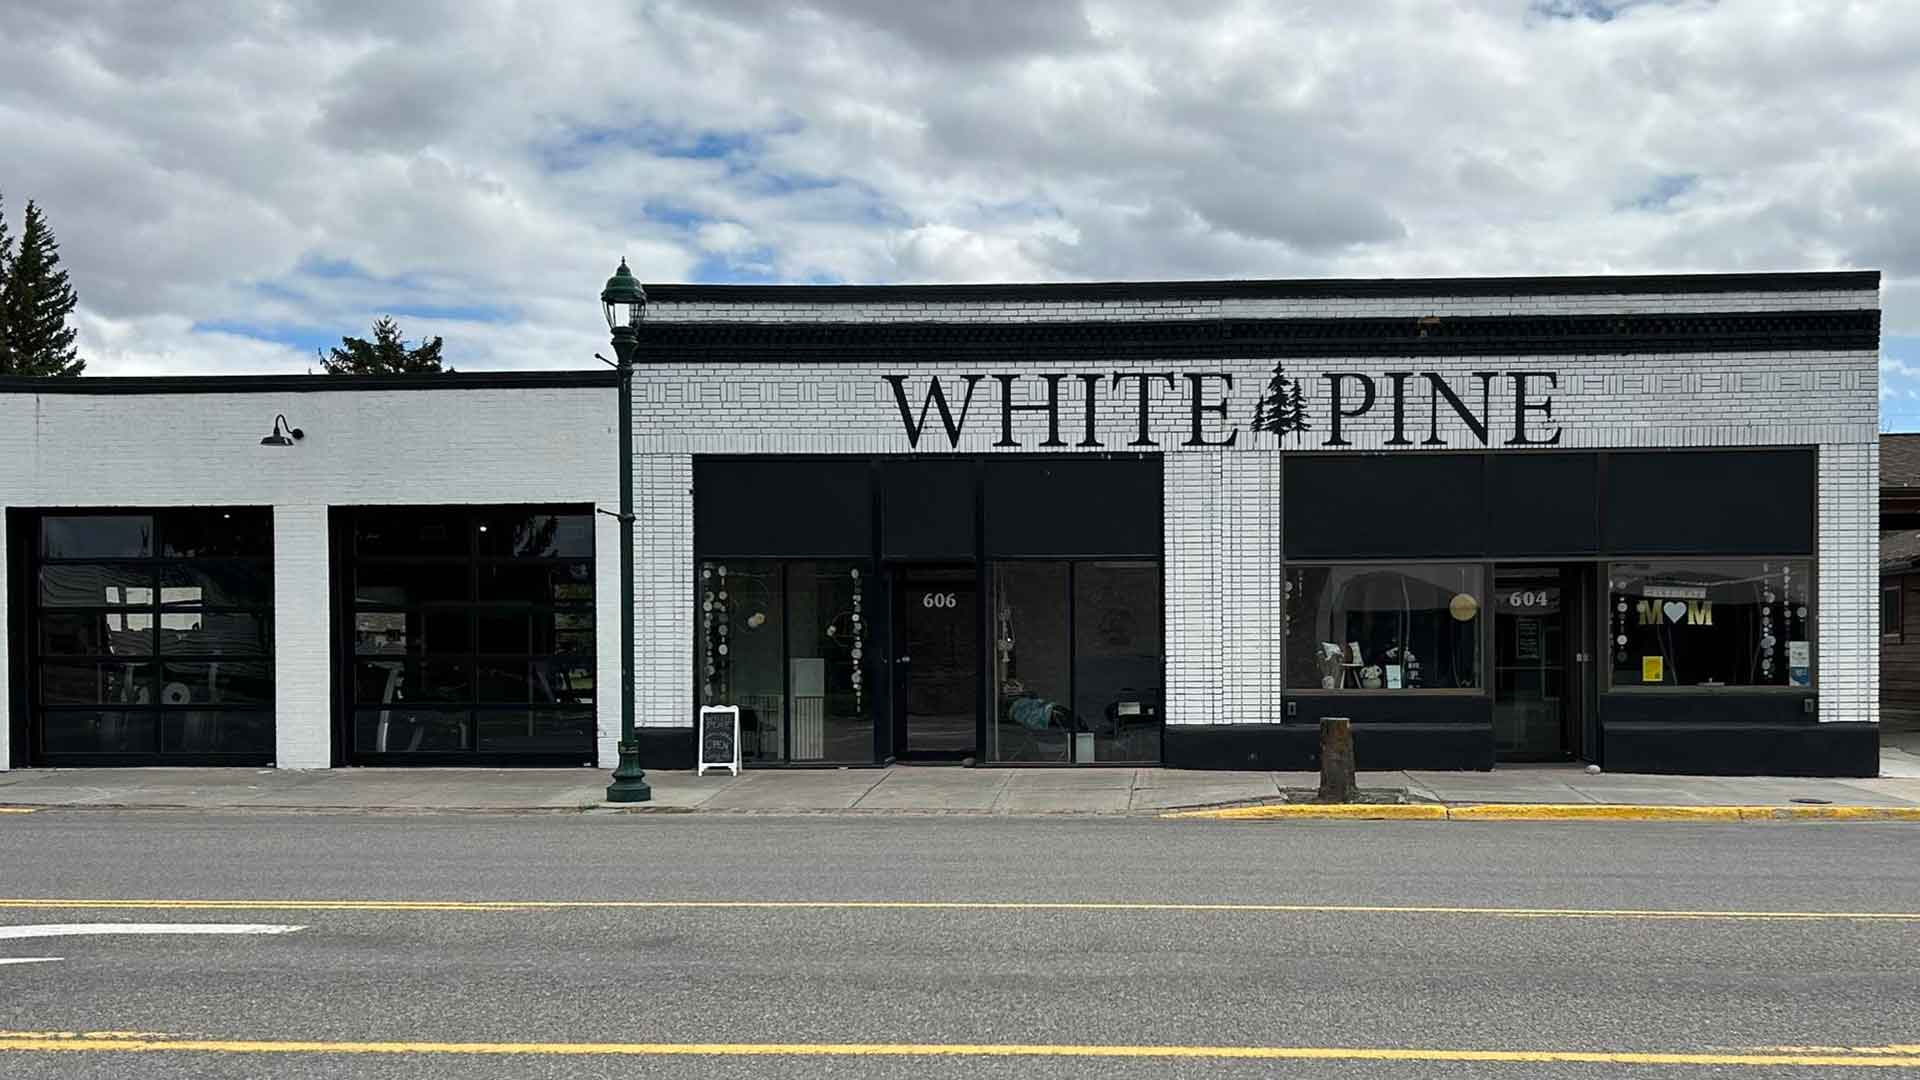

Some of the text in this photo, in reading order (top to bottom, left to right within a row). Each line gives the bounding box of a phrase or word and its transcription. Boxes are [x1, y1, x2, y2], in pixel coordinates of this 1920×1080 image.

[881, 370, 1563, 449] WHITE PINE
[923, 593, 957, 608] 606
[1509, 591, 1548, 607] 604
